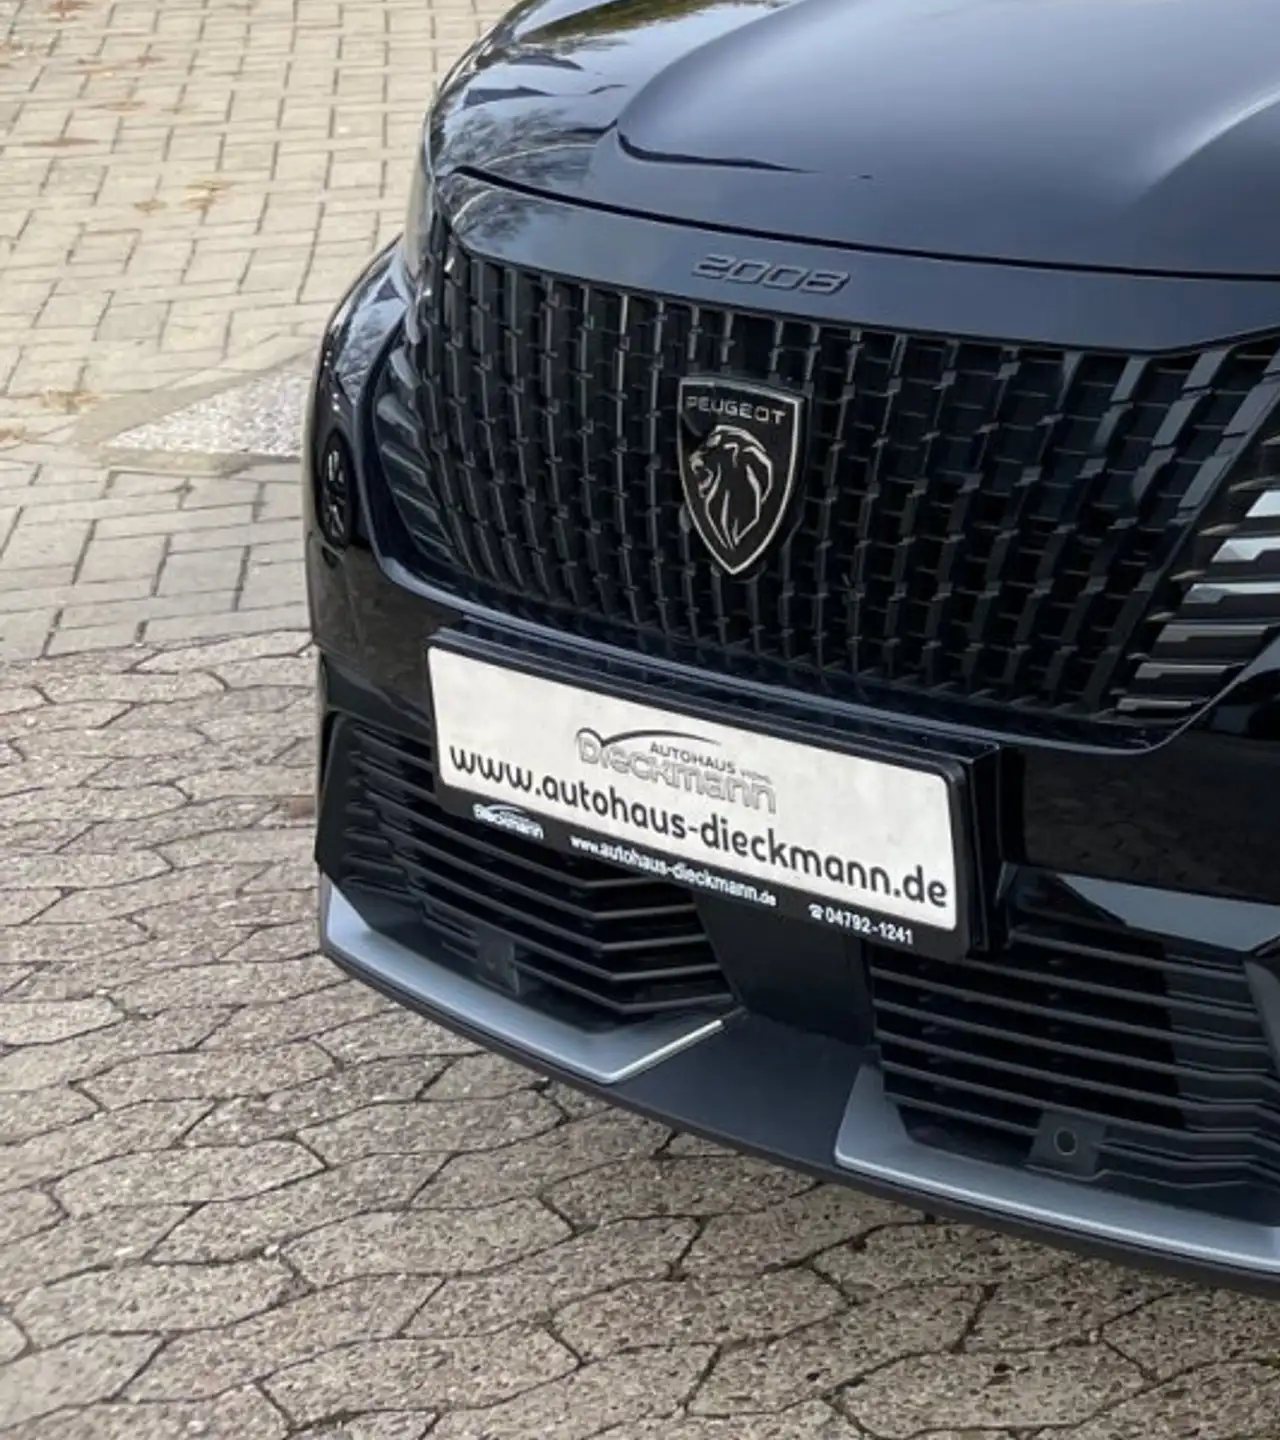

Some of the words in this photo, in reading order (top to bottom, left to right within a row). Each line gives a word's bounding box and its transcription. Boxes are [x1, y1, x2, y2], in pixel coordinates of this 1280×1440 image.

[691, 253, 851, 296] 2008
[685, 395, 786, 425] PEUGEOT
[649, 741, 737, 775] AUTOHAUS
[450, 744, 948, 909] www.autohaus-dieckmann.de
[569, 834, 778, 907] www.autohaus-dieckmann.de
[824, 907, 914, 946] 04792-1241
